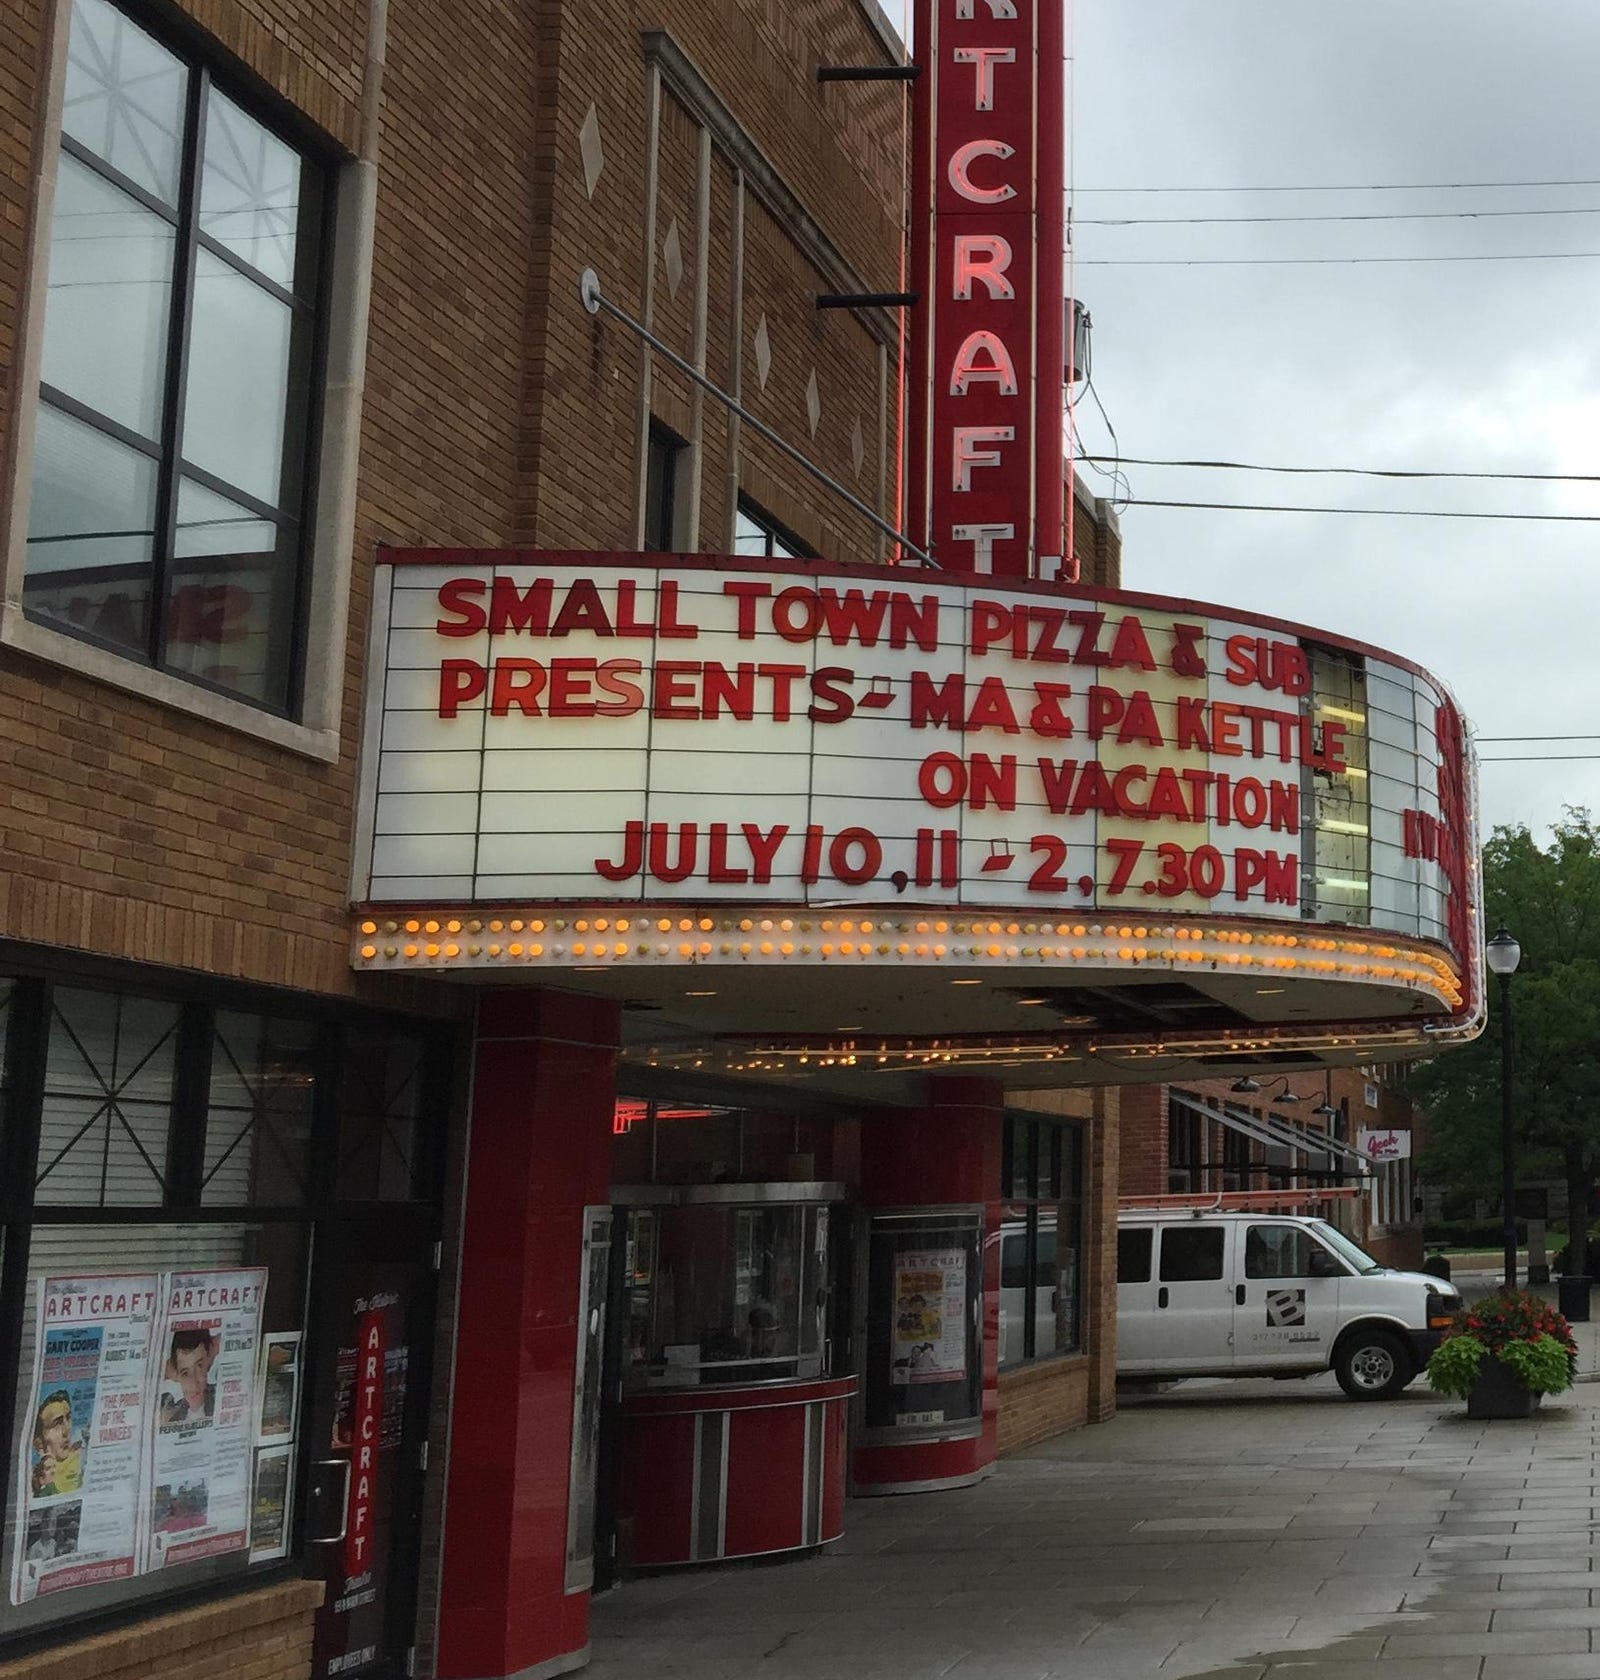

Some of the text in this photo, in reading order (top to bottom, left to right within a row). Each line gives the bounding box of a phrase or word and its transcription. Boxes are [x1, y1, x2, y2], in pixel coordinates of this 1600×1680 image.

[437, 577, 1312, 697] SMALL TOWN PIZZA & SUB
[1176, 696, 1347, 773] KETTLE
[918, 751, 1299, 835] ON VACATION
[594, 820, 790, 884] JULY
[1235, 847, 1298, 907] PM
[47, 1292, 154, 1317] ARTCRAFT
[171, 1285, 262, 1309] ARTCRAFT
[1265, 1289, 1306, 1327] B
[352, 1326, 380, 1561] ARTCRAFT
